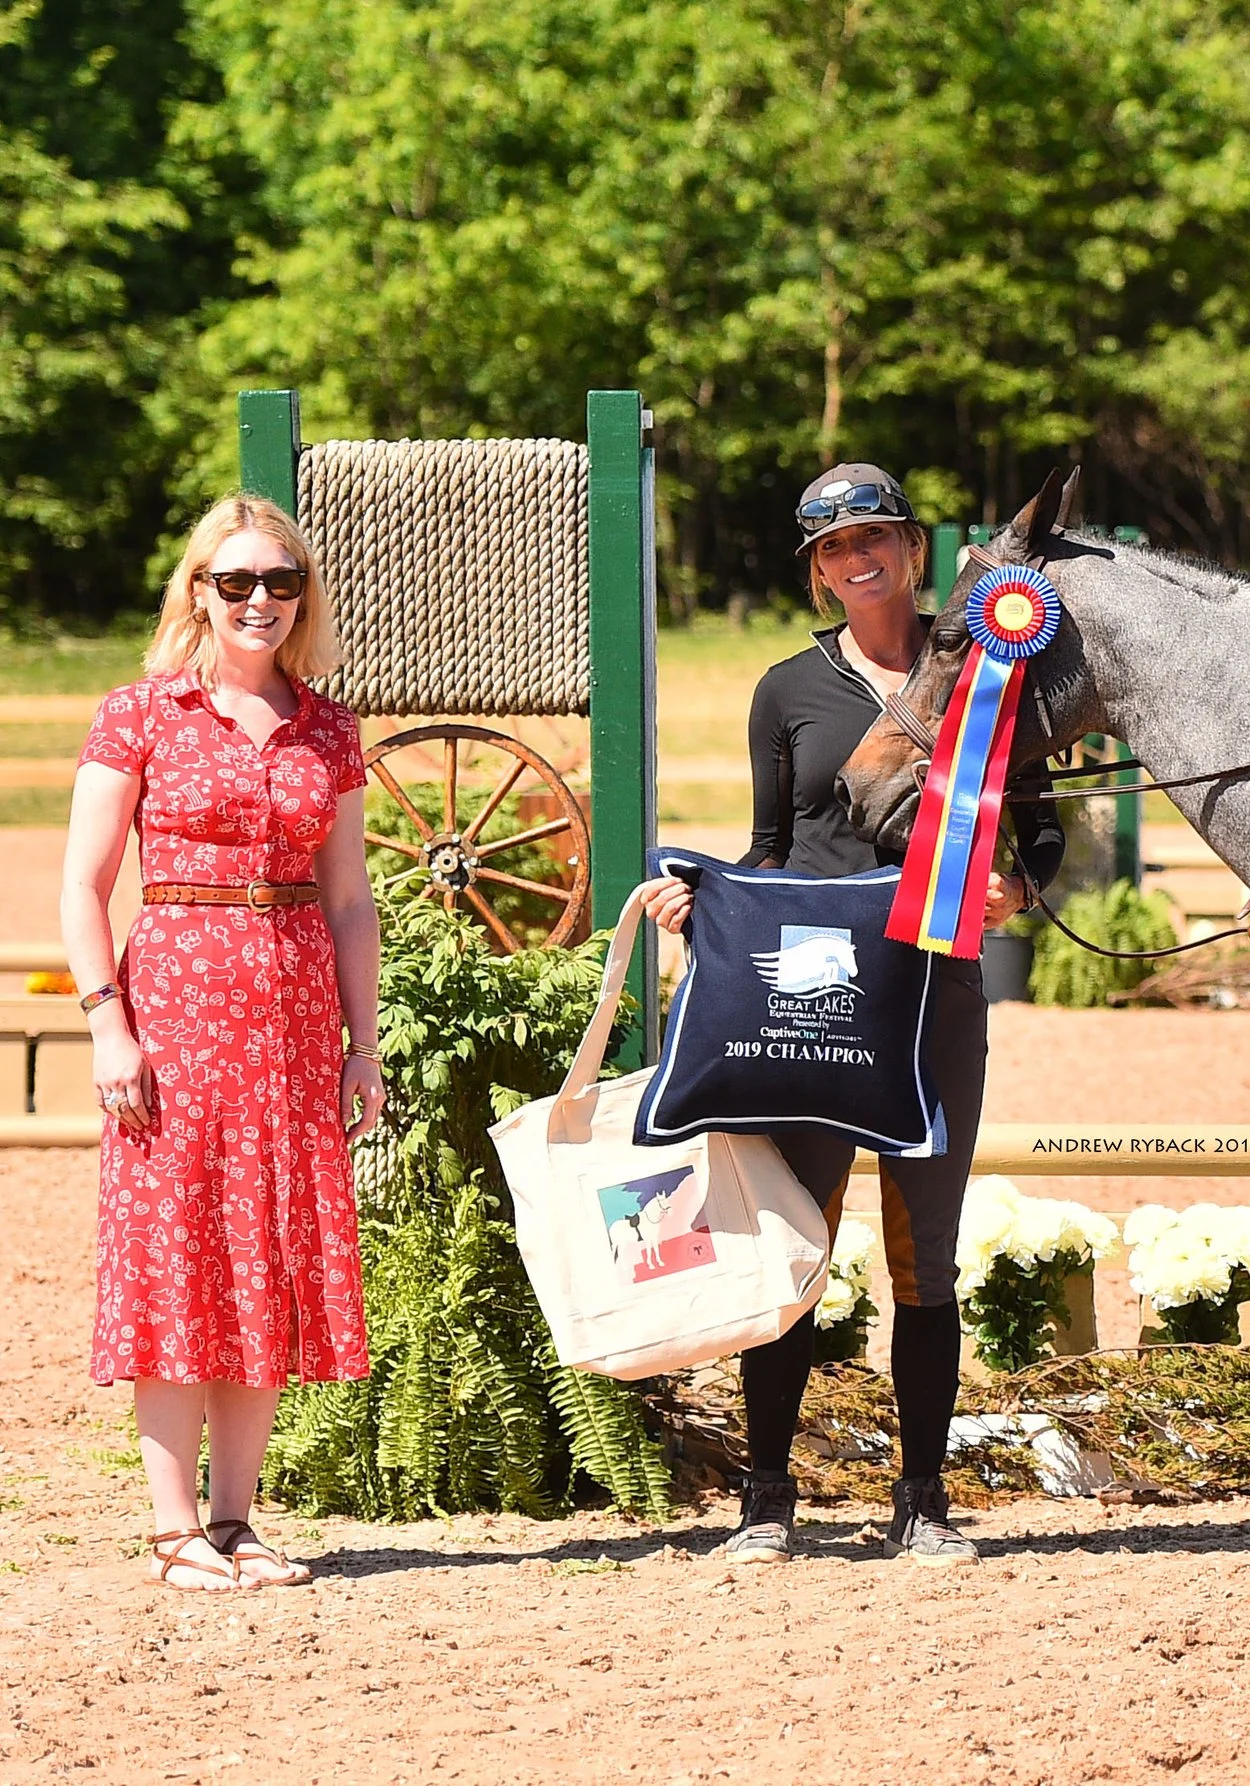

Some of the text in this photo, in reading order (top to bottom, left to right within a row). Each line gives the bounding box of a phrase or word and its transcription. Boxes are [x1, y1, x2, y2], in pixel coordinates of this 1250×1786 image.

[767, 993, 856, 1014] GREAT LAKES
[760, 1026, 819, 1040] CaptiveOne
[724, 1041, 876, 1067] 2019 CHAMPION
